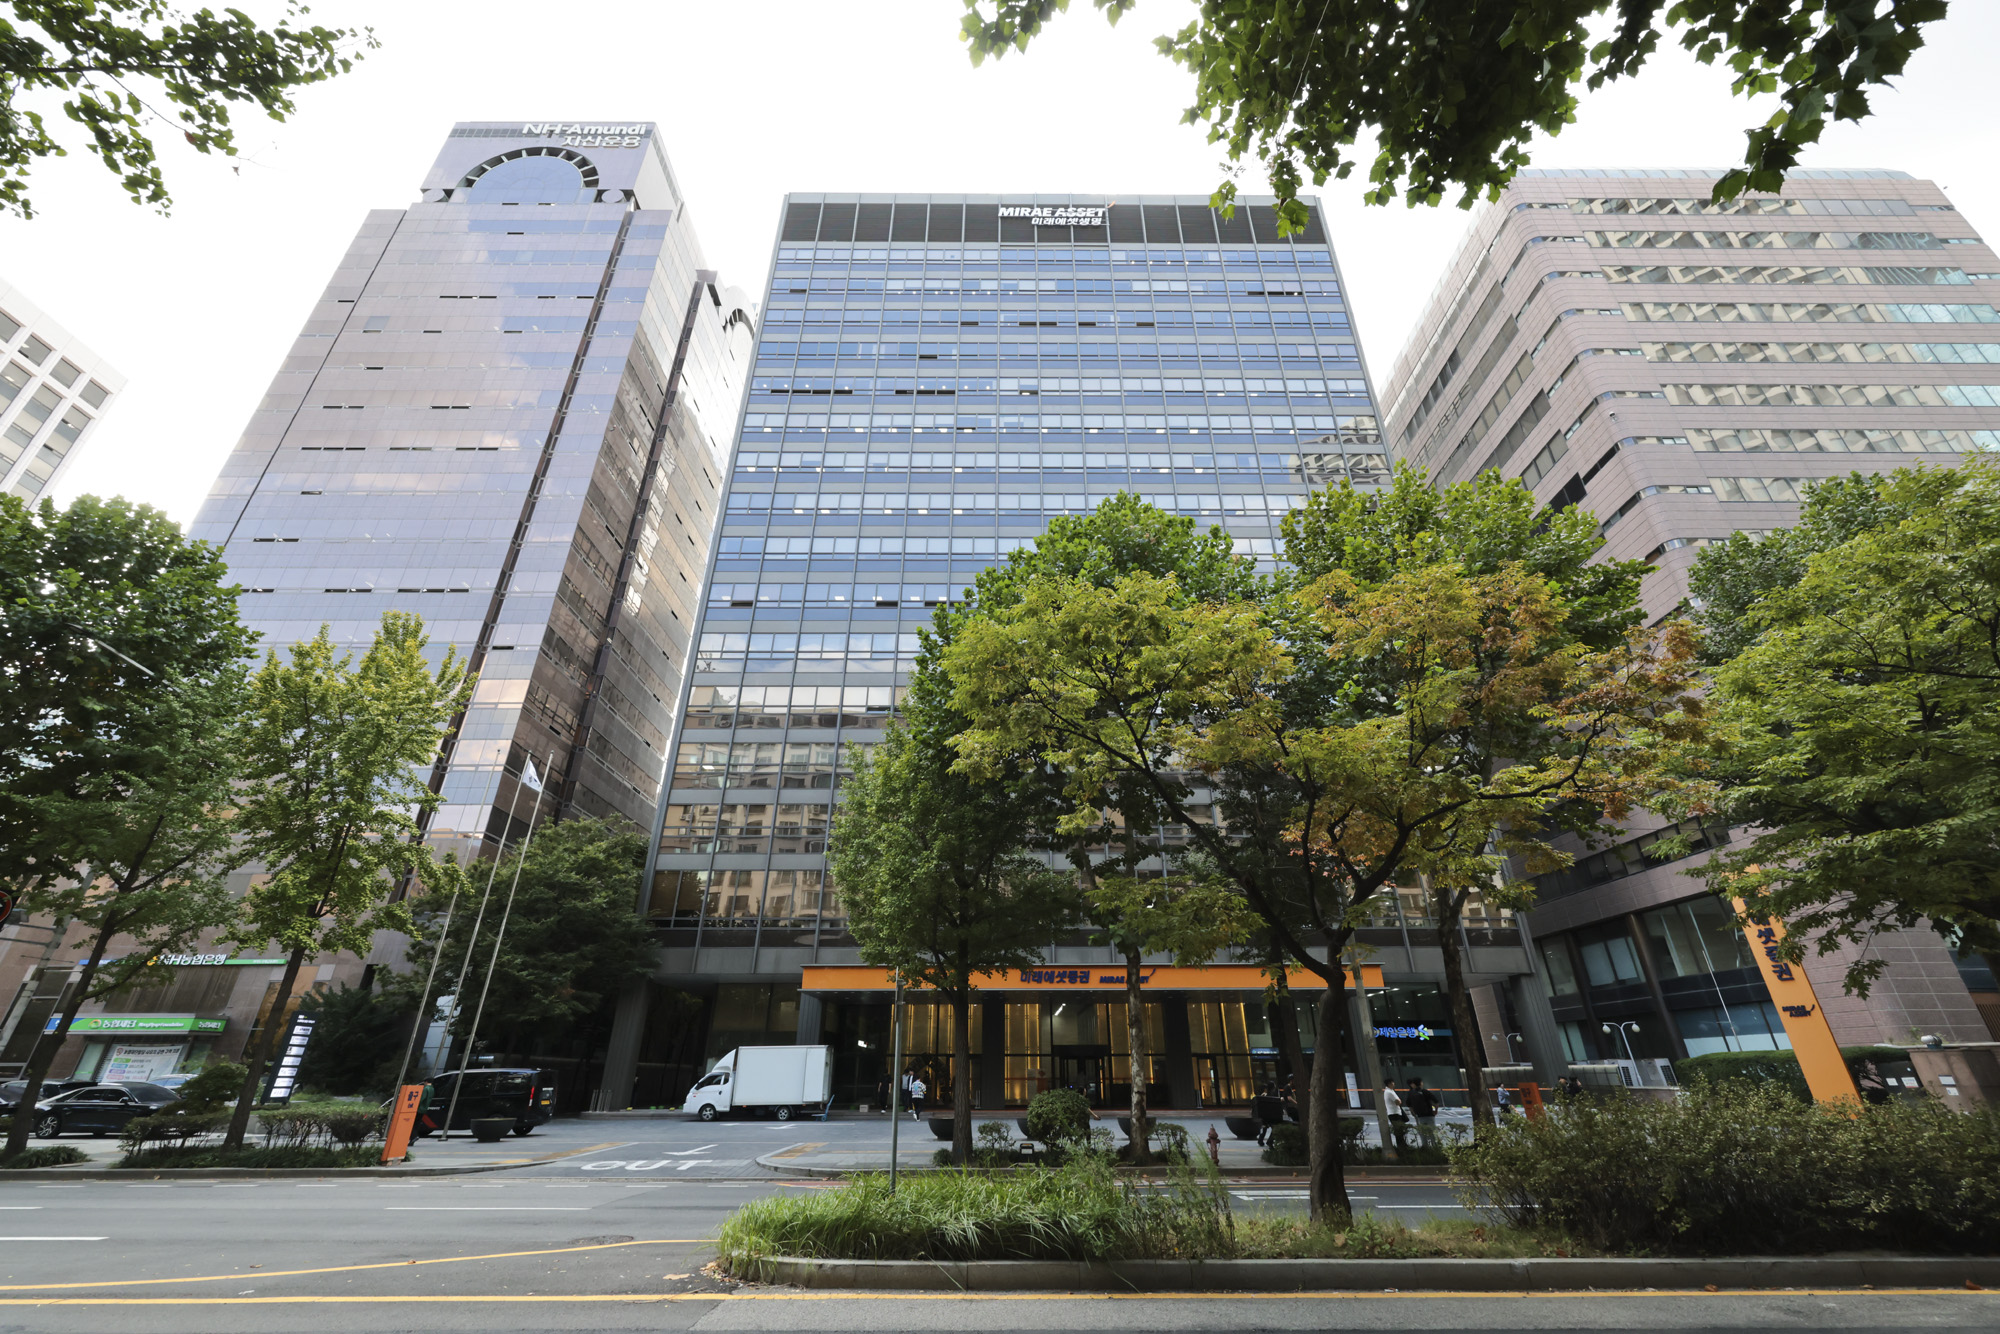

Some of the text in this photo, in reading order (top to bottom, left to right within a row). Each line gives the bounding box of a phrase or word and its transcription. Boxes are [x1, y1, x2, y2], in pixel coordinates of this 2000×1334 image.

[522, 123, 647, 135] NH-Amundi
[562, 135, 641, 148] 자산운용
[998, 207, 1106, 217] MIRAE ASSET
[1031, 217, 1103, 226] 미래에셋생명
[1020, 970, 1090, 984] 미래에셋증권
[1099, 976, 1125, 984] MIRAE
[580, 1159, 713, 1171] OUT
